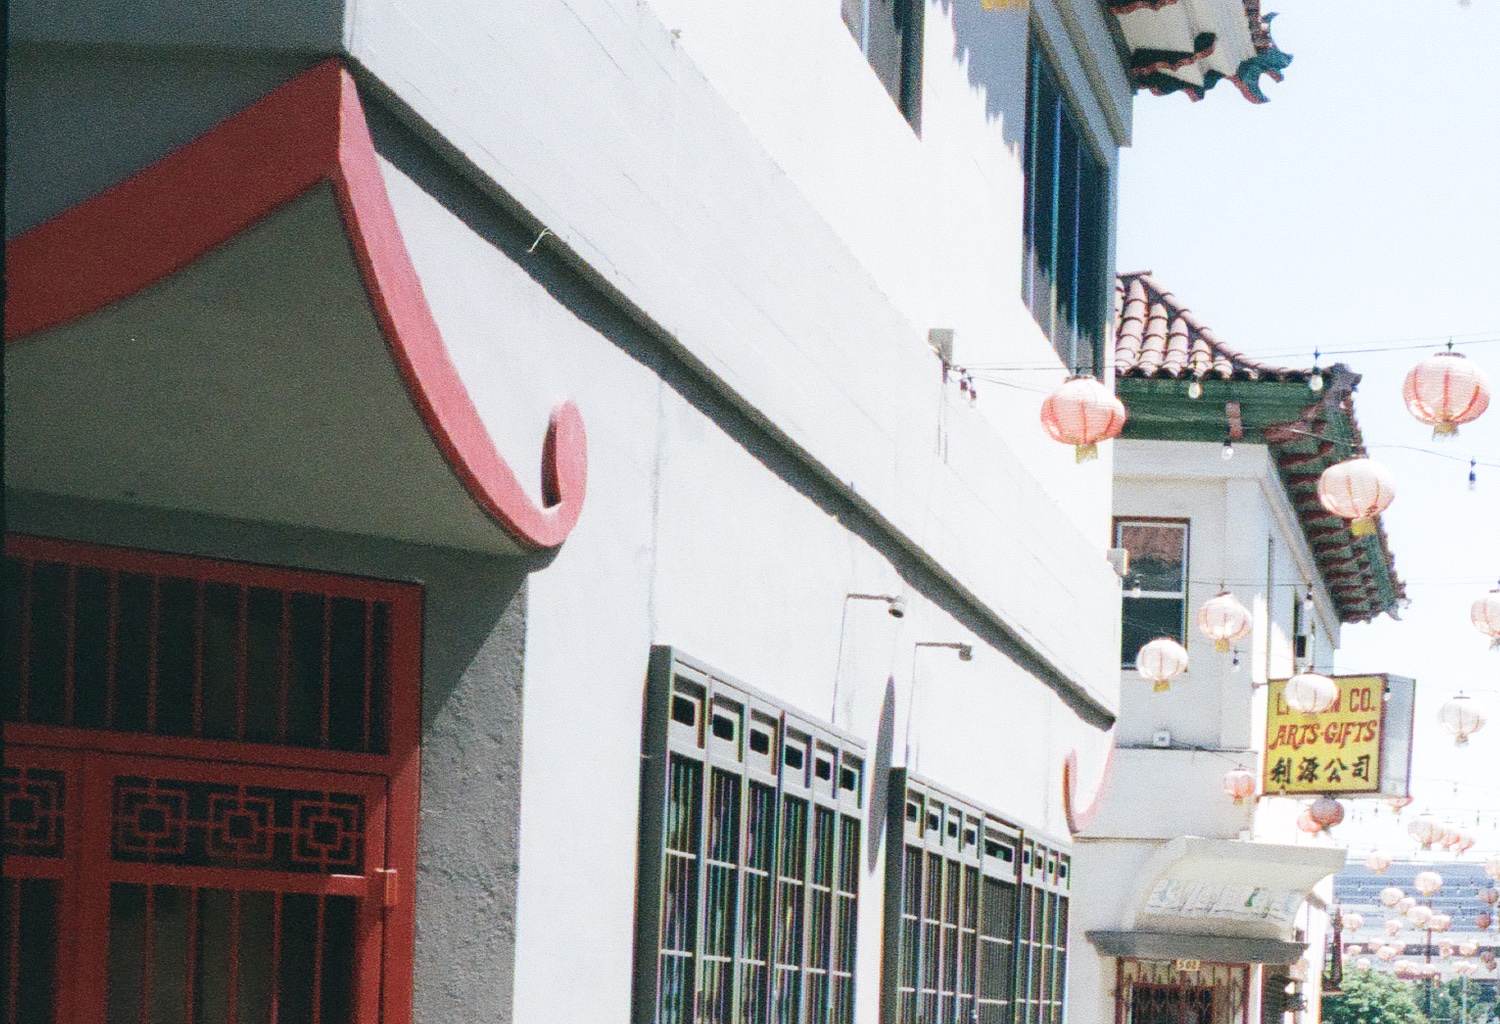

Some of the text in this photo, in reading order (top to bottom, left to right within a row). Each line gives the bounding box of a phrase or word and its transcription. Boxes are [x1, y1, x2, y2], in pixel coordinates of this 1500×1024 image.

[1349, 687, 1376, 713] CO.
[1270, 753, 1371, 785] 利源公司
